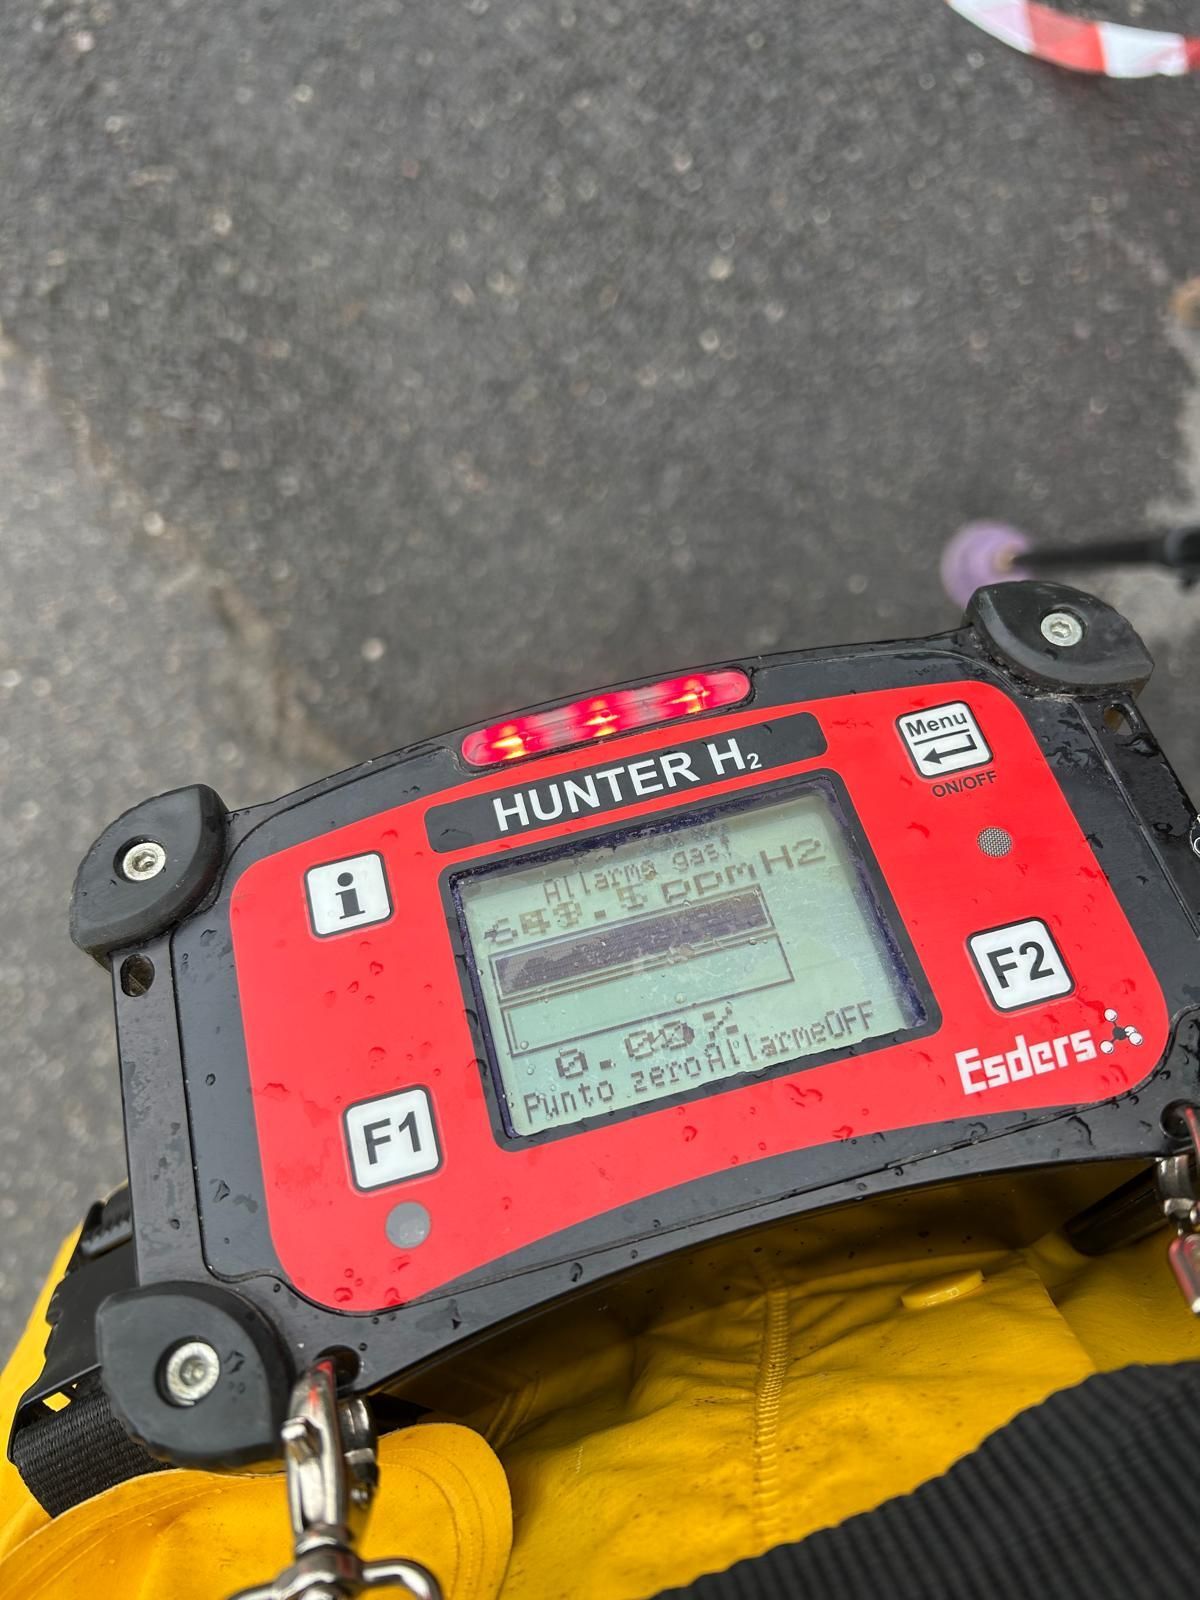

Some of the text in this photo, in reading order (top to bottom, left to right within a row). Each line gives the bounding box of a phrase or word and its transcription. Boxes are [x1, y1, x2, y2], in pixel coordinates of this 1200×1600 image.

[904, 710, 969, 739] Menu
[492, 751, 700, 832] HUNTER
[931, 770, 998, 799] ON/OFF
[543, 858, 658, 904] Allarme
[986, 940, 1055, 990] F2
[953, 1029, 1098, 1096] Esders
[523, 1081, 615, 1125] Punto
[361, 1109, 423, 1166] F1
